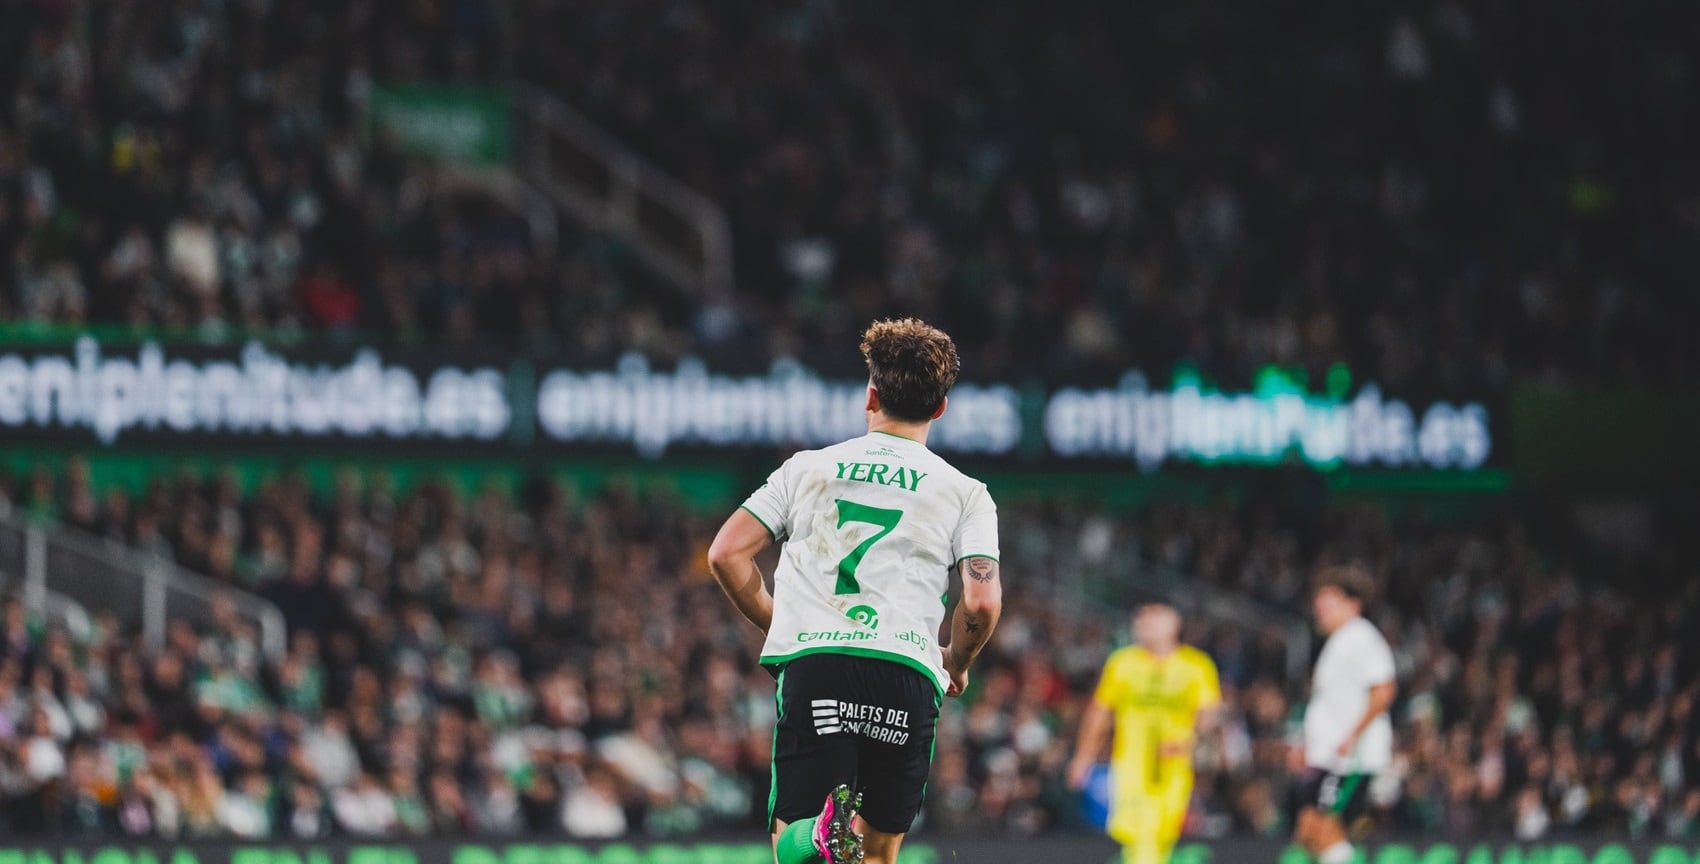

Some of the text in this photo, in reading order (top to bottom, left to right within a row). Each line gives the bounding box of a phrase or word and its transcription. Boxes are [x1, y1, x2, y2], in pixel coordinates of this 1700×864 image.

[0, 334, 510, 445] eniplenitude.es
[835, 462, 928, 492] YERAY
[834, 498, 904, 596] 7
[895, 629, 928, 651] abs
[839, 701, 909, 728] PALETS DEL
